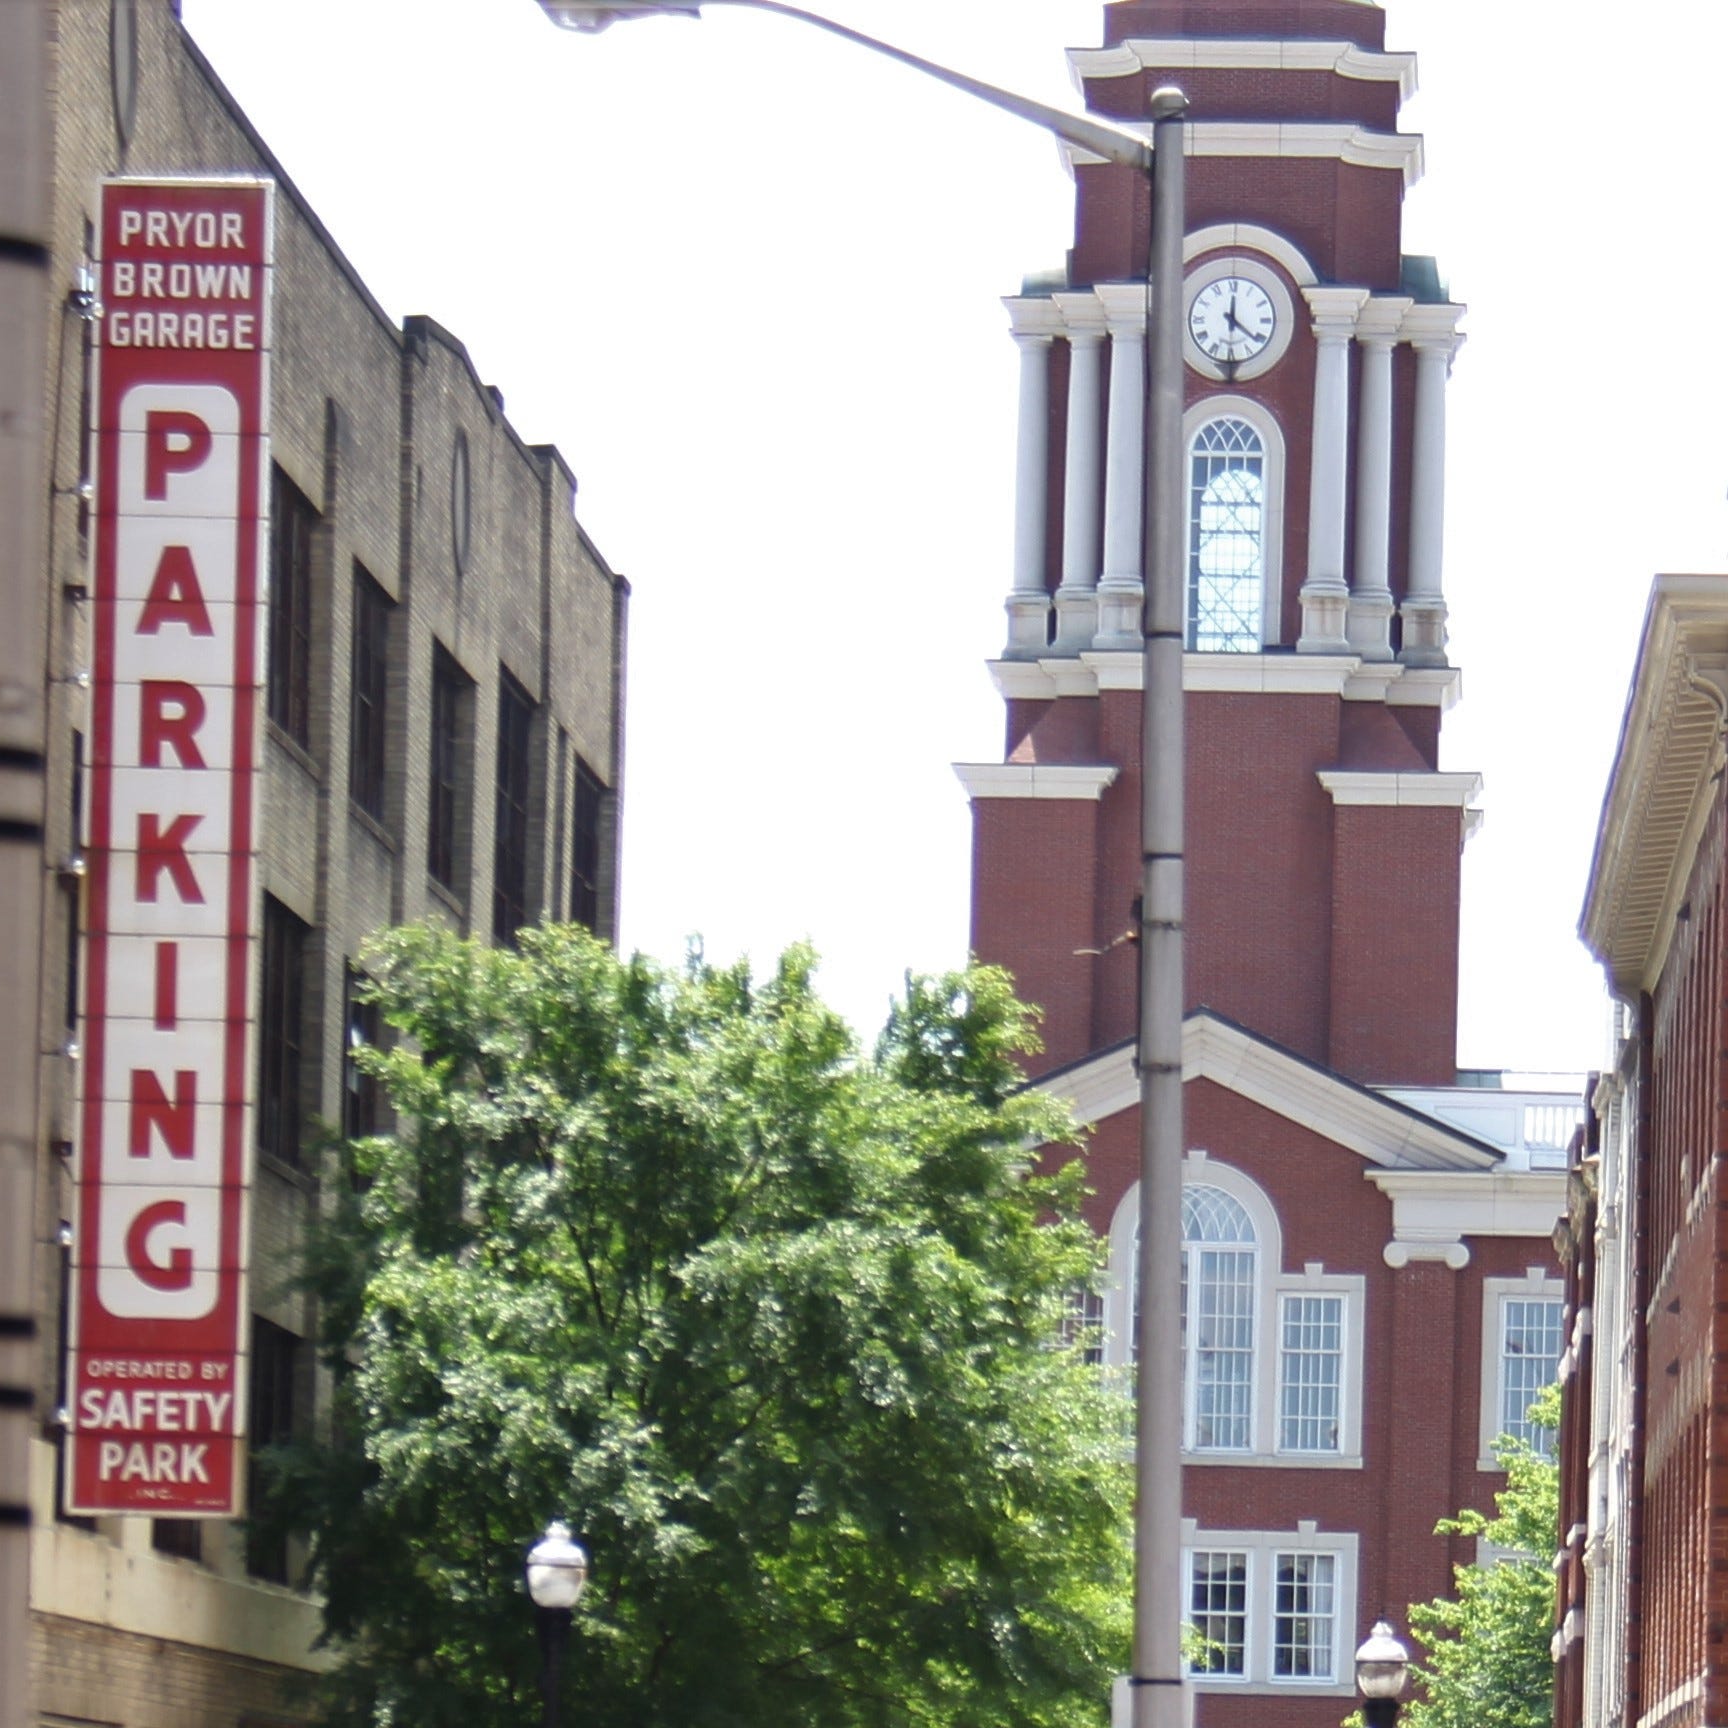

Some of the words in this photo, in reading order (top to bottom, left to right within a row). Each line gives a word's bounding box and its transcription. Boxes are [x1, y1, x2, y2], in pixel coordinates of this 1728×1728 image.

[120, 210, 245, 249] PRYOR
[113, 262, 251, 299] BROWN
[109, 311, 255, 350] GARAGE
[125, 410, 213, 1292] PARKING
[87, 1360, 192, 1380] OPERATED
[200, 1361, 227, 1380] BY
[80, 1389, 231, 1432] SAFETY
[99, 1441, 210, 1483] PARK
